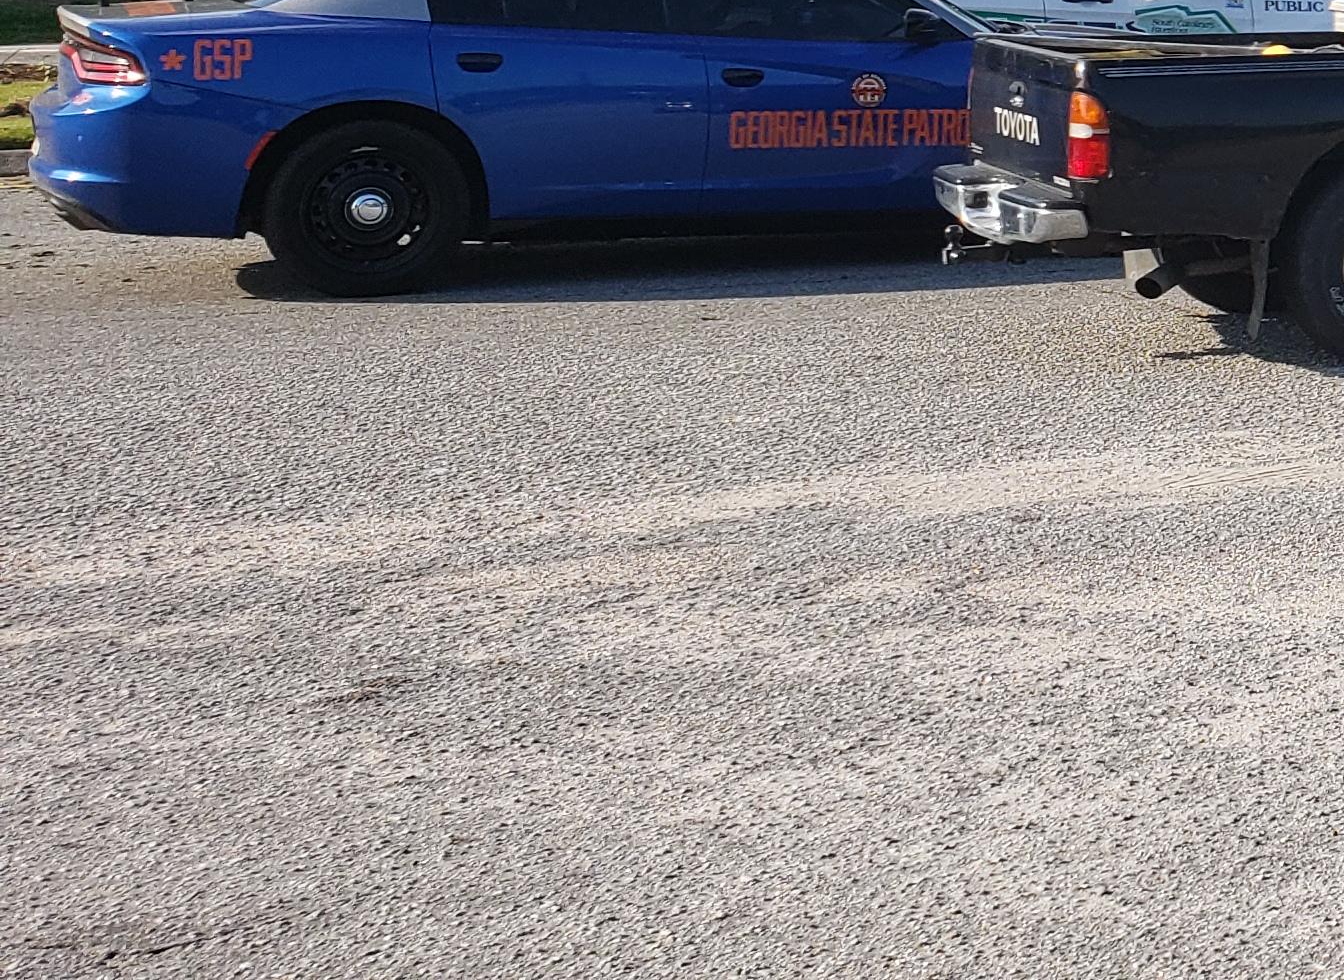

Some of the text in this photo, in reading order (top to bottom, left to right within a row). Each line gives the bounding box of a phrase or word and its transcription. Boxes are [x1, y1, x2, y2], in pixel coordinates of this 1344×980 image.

[1264, 0, 1325, 12] PUBLIC
[193, 39, 253, 81] GSP
[729, 108, 971, 149] GEORGIA STATE PATRO
[993, 106, 1041, 146] TOYOTA
